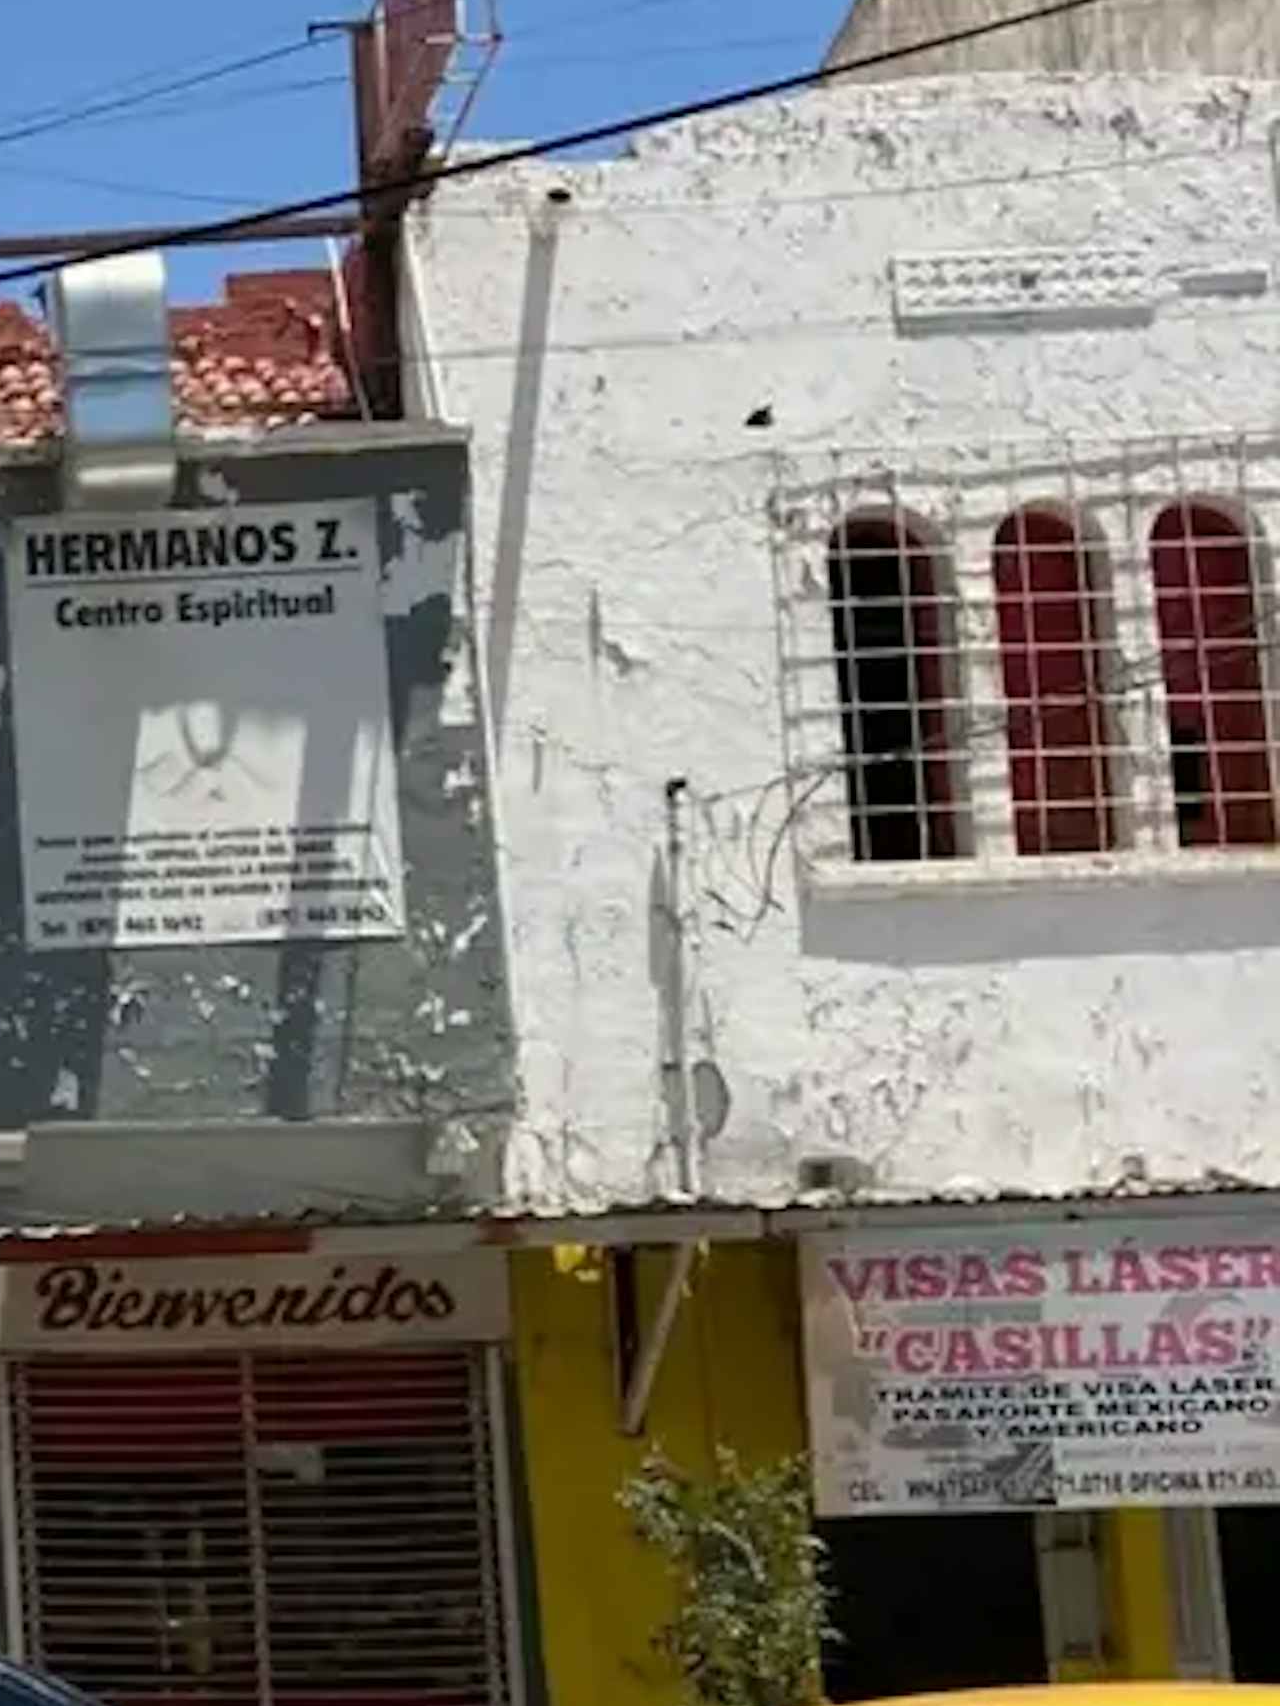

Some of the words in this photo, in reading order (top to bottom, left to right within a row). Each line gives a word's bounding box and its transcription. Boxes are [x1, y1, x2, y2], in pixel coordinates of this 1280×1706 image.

[25, 520, 299, 578] HERMANOS
[314, 518, 360, 561] Z.
[55, 596, 164, 629] Centro
[177, 585, 335, 628] Espiritual
[34, 1265, 457, 1331] Bienvenidos
[826, 1250, 1048, 1303] VISAS
[891, 1400, 1083, 1422] PASAPORTE
[1096, 1394, 1271, 1417] MEXICANO
[1029, 1380, 1072, 1399] DE
[1082, 1378, 1159, 1397] VISA
[1007, 1419, 1203, 1438] AMERICANO
